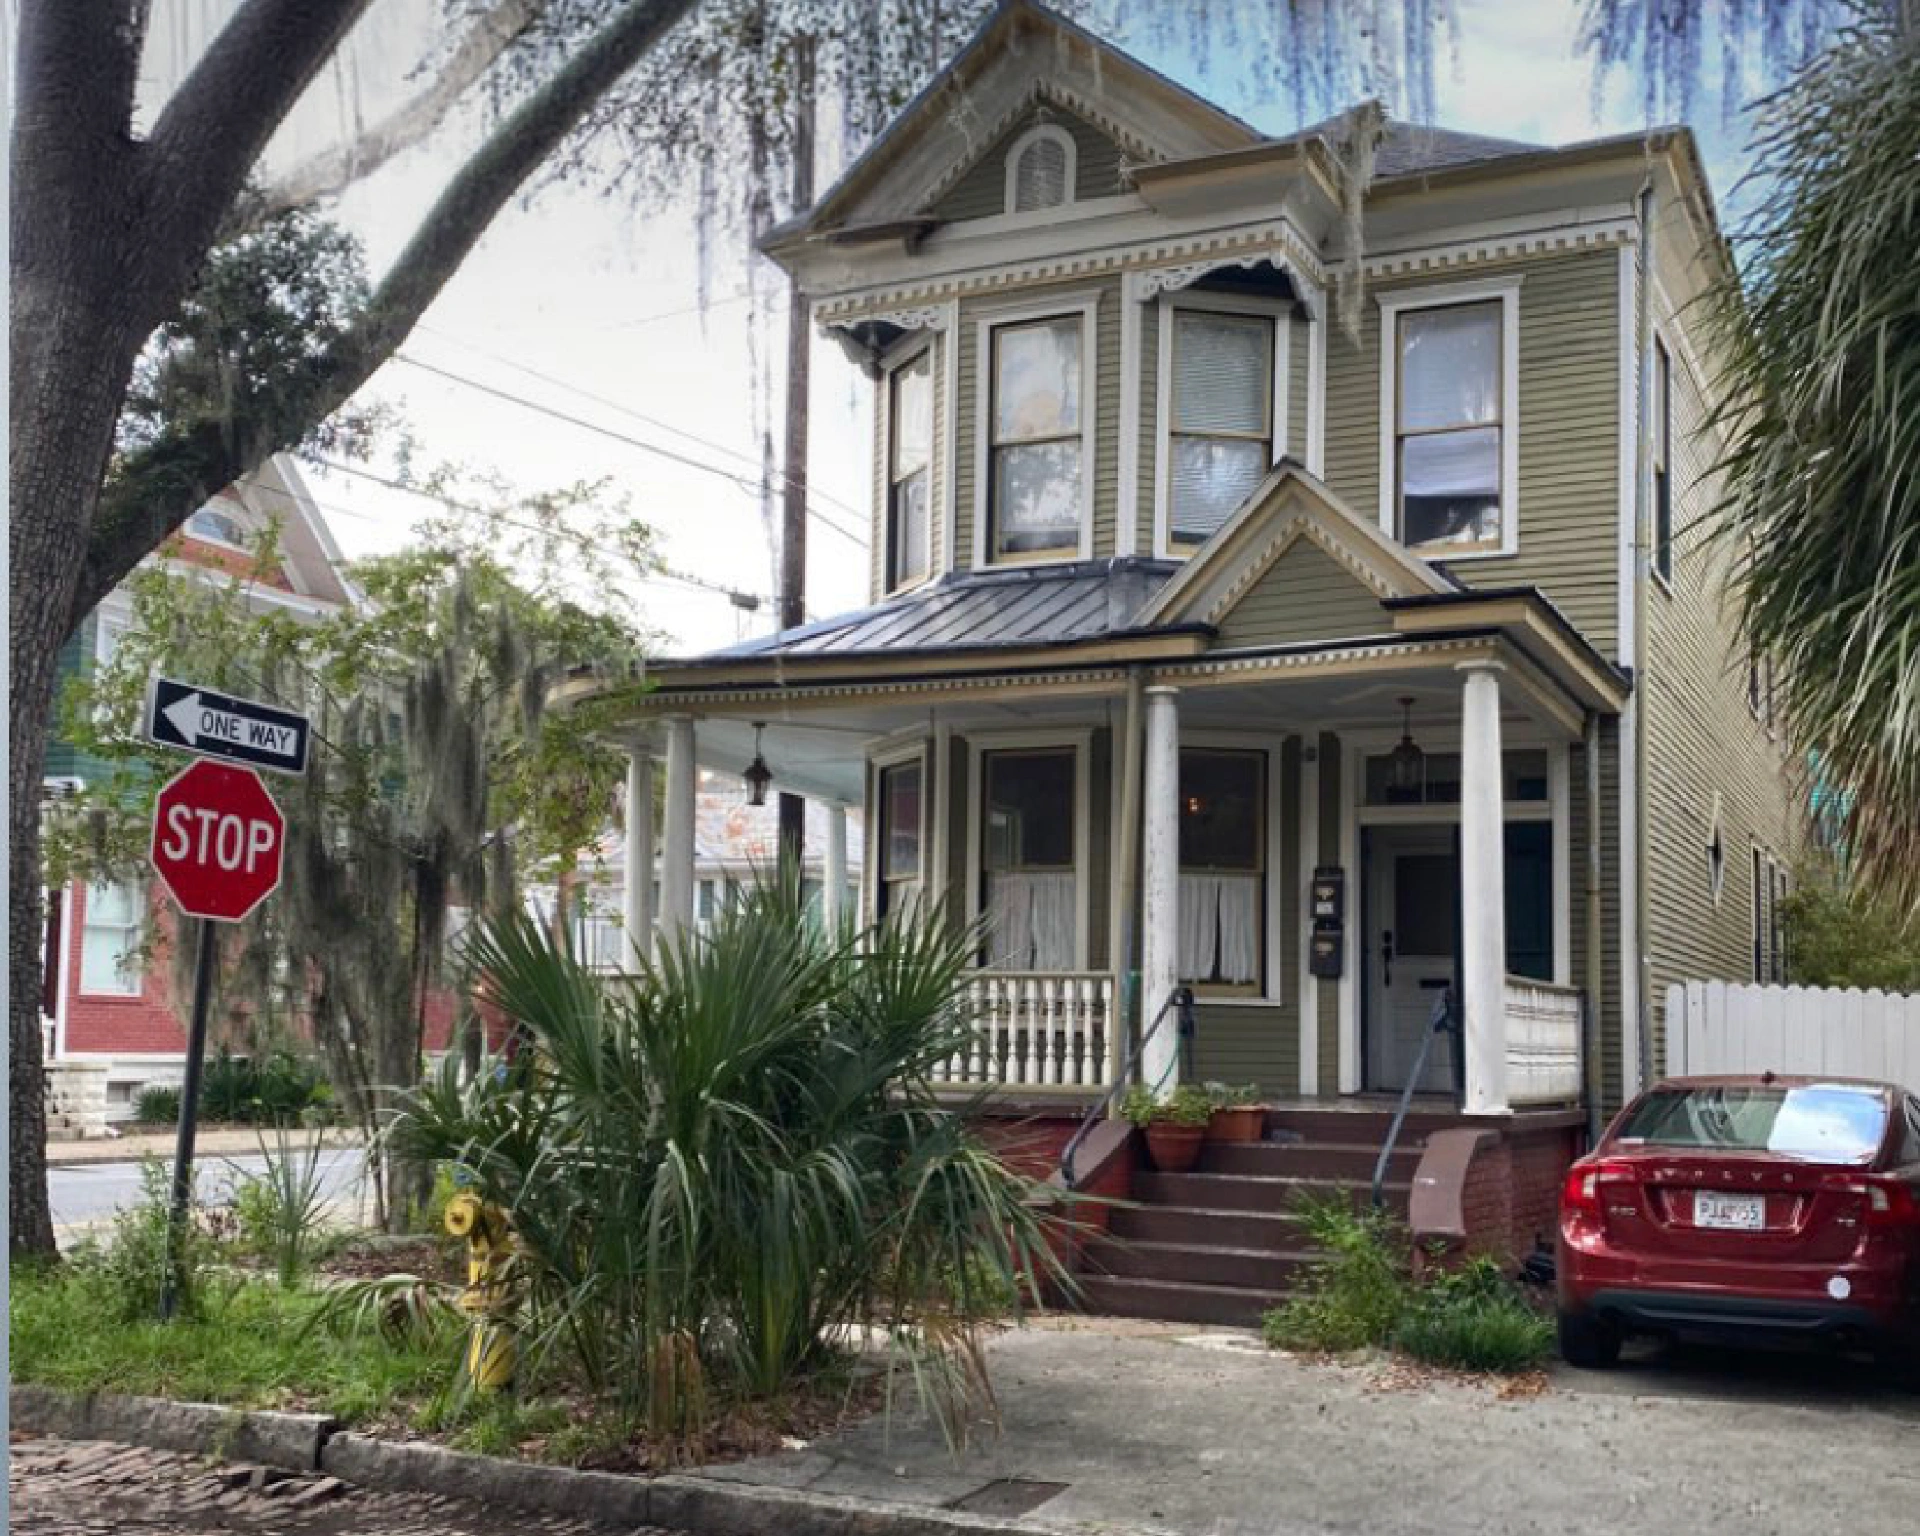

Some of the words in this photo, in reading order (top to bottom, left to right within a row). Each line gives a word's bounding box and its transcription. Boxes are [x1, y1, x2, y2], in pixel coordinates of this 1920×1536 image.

[202, 711, 240, 740] ONE
[249, 722, 291, 750] WAY
[162, 803, 275, 873] STOP
